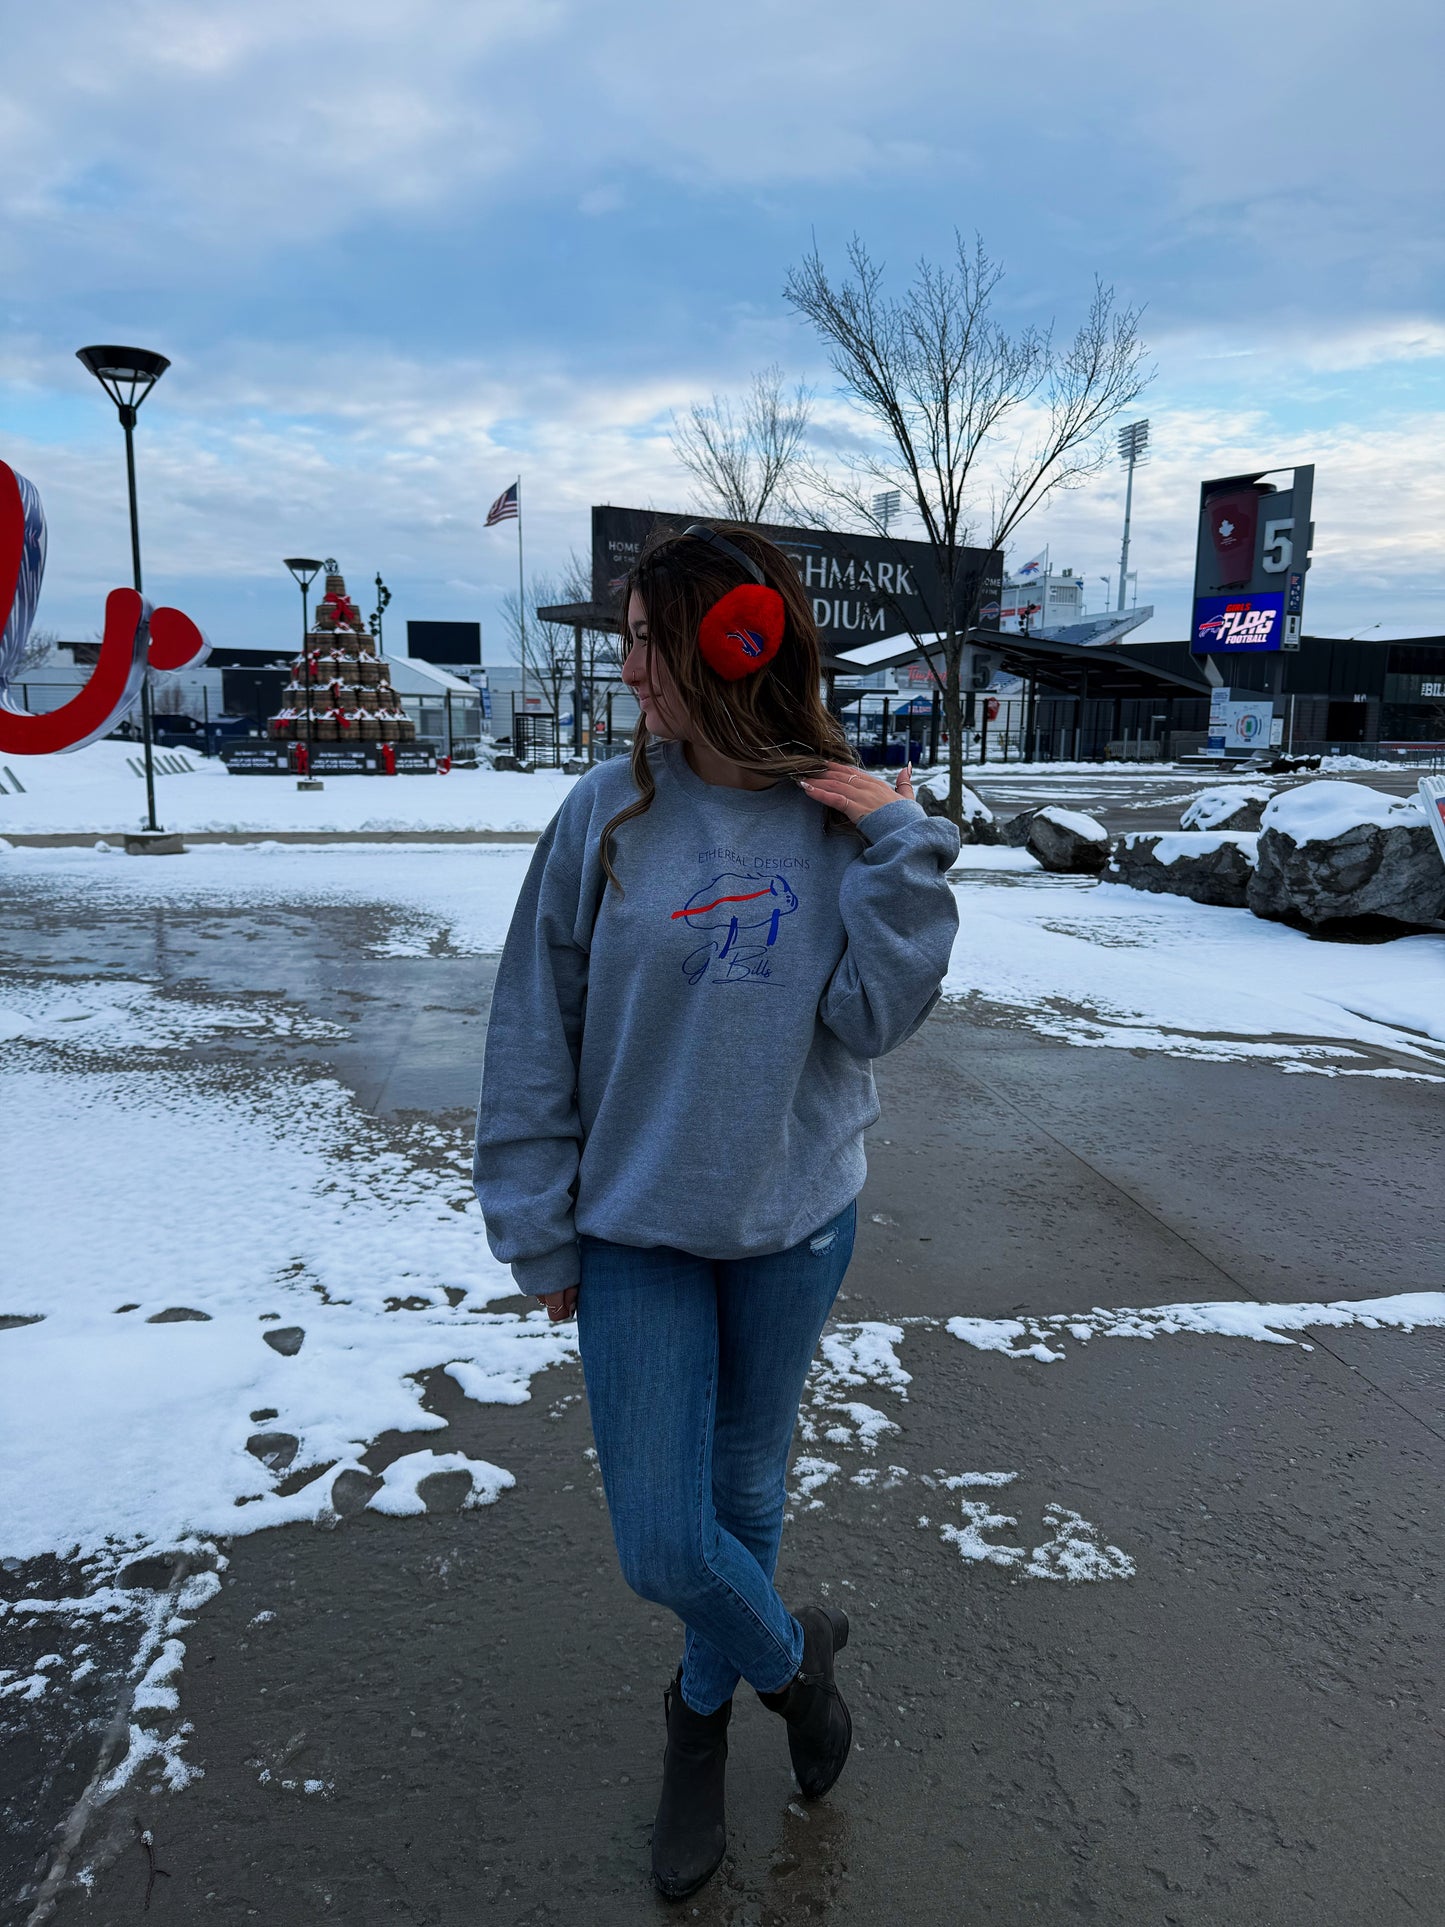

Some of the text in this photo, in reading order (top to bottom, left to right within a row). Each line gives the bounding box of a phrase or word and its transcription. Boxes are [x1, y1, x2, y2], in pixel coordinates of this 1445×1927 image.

[608, 540, 641, 553] HOME
[1262, 518, 1295, 573] 5
[785, 553, 914, 595] GHMARK
[812, 598, 886, 632] DIUM
[1226, 602, 1252, 612] GIRLS
[1216, 610, 1277, 640] FLAG
[1225, 634, 1267, 644] FOOTBALL
[972, 654, 992, 689] 5
[1424, 682, 1445, 697] BIL
[698, 848, 810, 870] ETHEREAL DESIGNS
[715, 945, 780, 985] Bills
